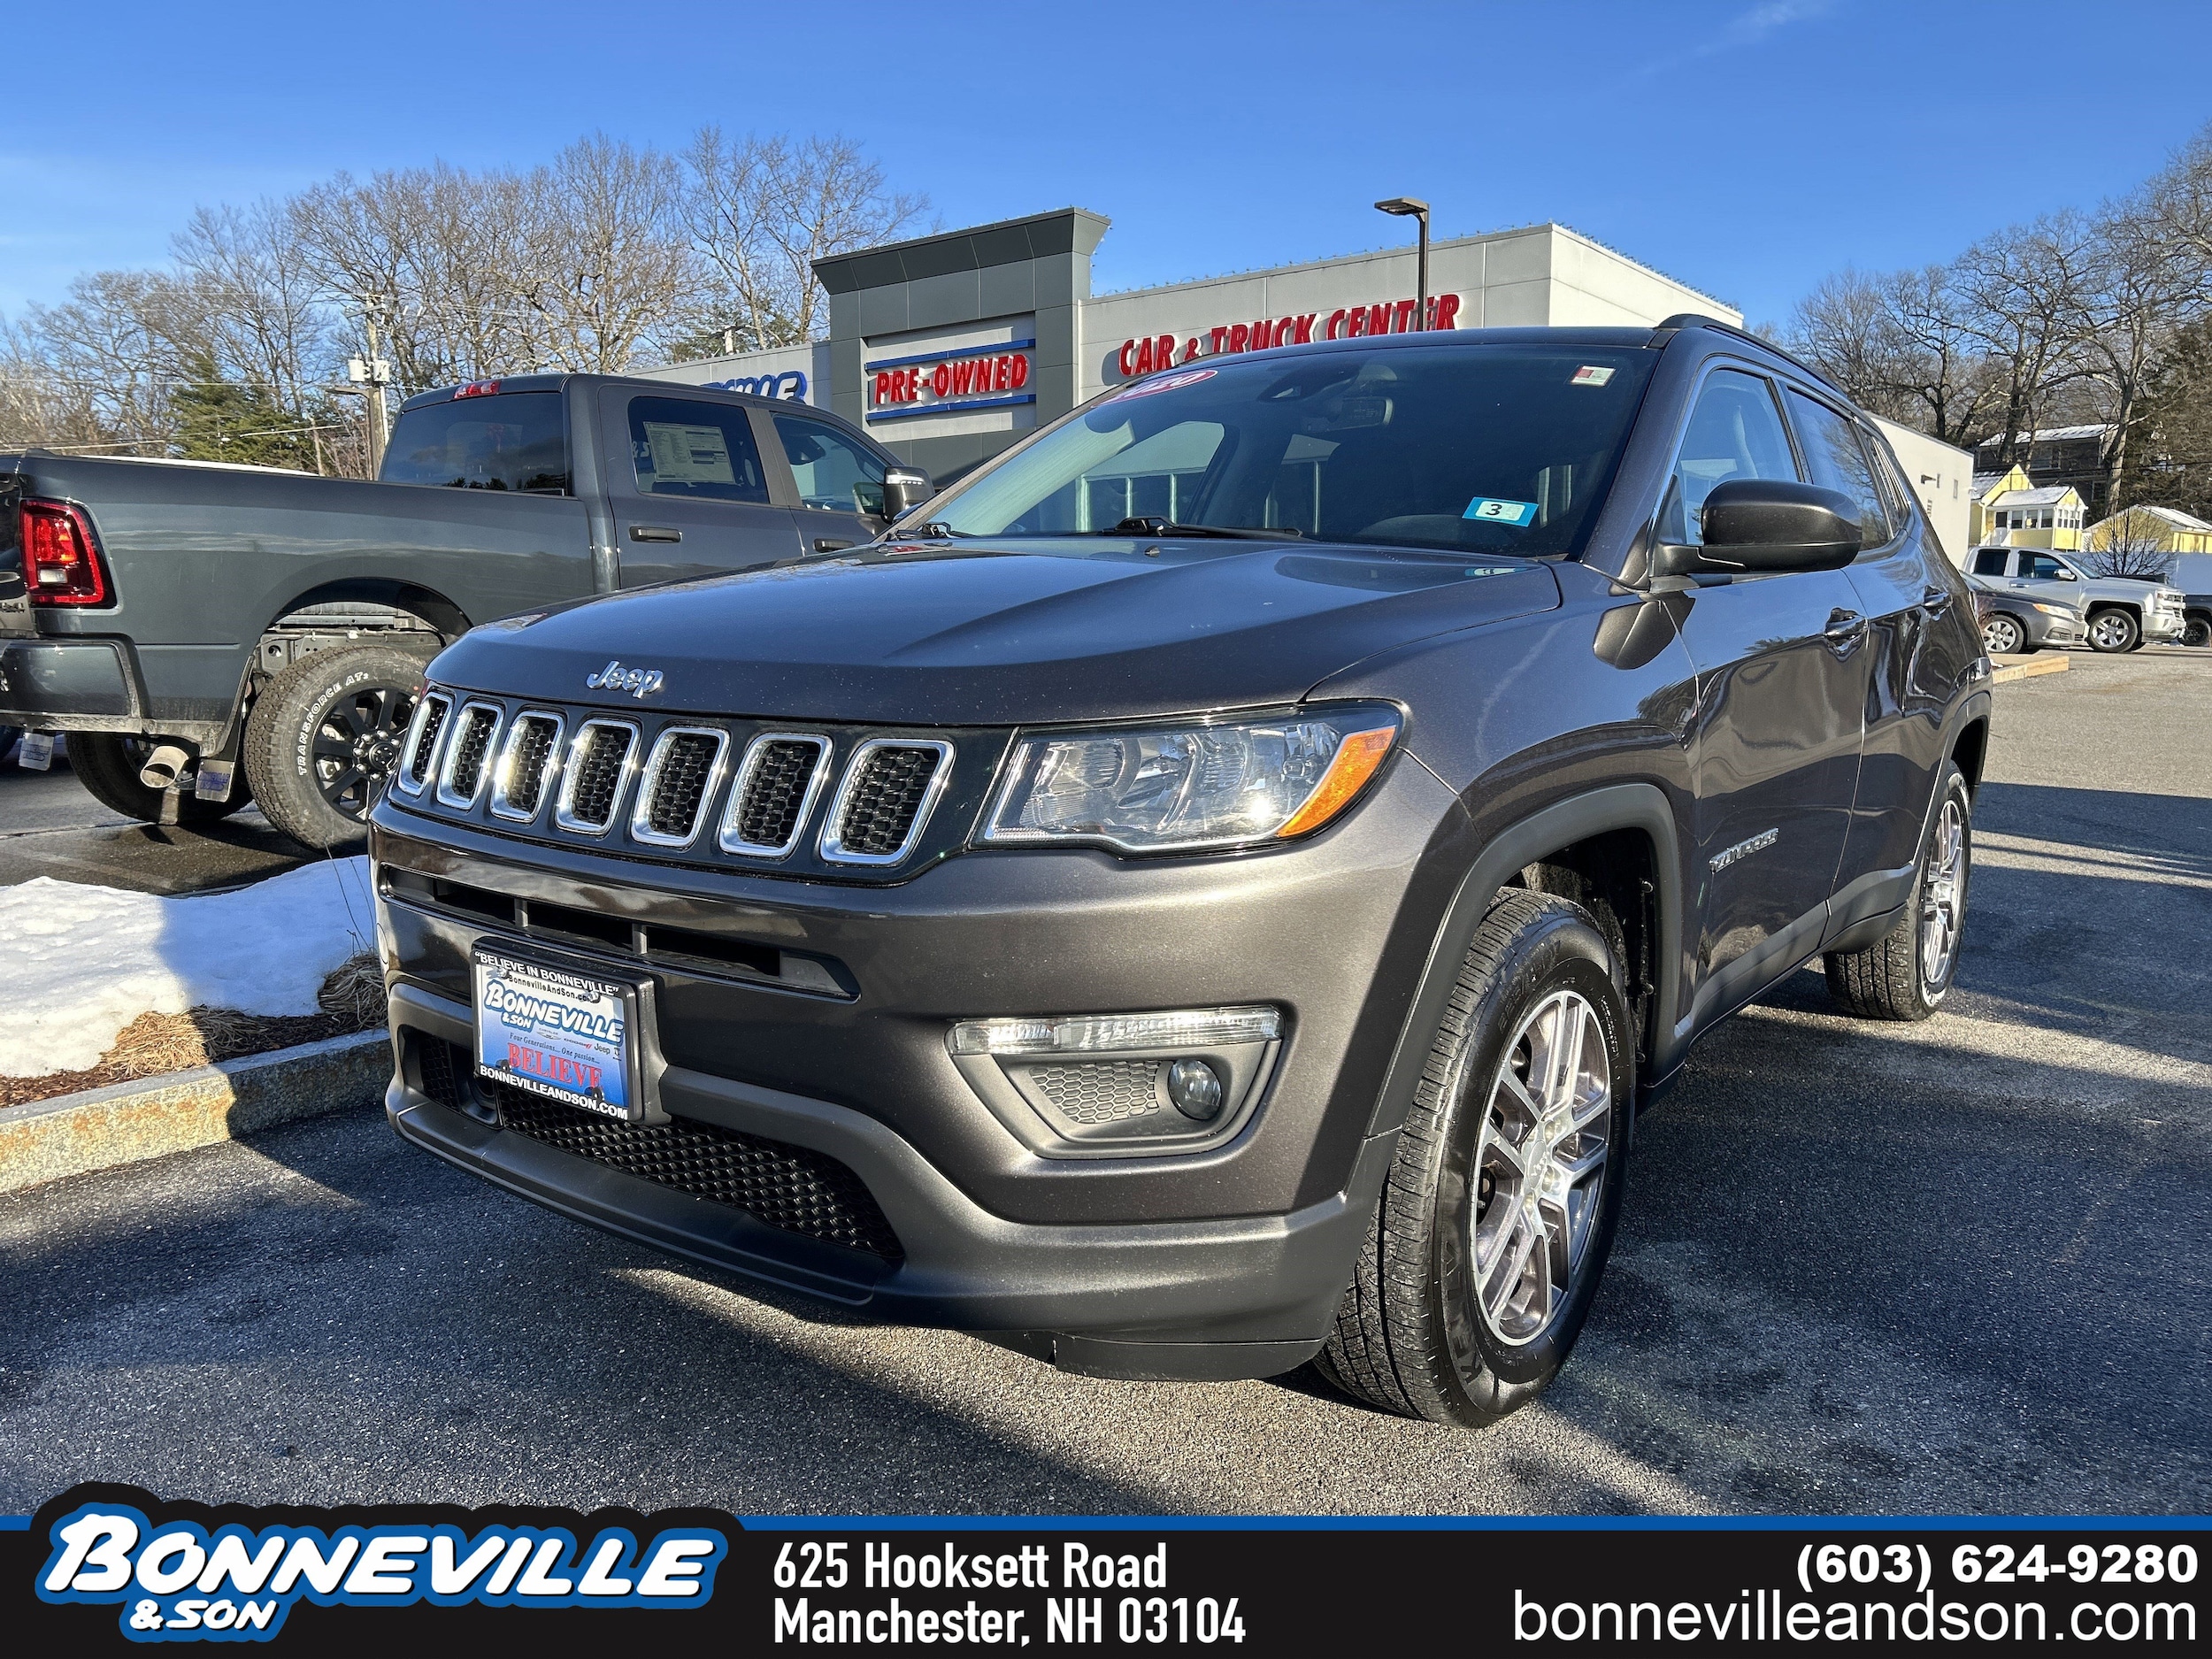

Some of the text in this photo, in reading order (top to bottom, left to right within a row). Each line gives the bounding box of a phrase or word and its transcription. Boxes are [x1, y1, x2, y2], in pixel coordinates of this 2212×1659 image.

[1118, 334, 1178, 377] CAR
[1210, 312, 1320, 353] TRUCK
[1326, 293, 1462, 341] CENTER
[874, 353, 1030, 405] PRE-OWNED
[1485, 503, 1502, 516] 3
[586, 659, 664, 699] Jeep
[297, 681, 343, 776] TRANSFORCE
[509, 975, 595, 1002] BonnevilleAndSon.co
[526, 965, 539, 978] IN
[485, 981, 625, 1043] BONNEVILLE
[507, 1041, 603, 1089] BELIEVE
[510, 1032, 523, 1045] Four
[561, 1047, 573, 1056] One
[594, 1042, 611, 1056] Jeep
[479, 1065, 629, 1121] BONNEVILLEANDSON.COM
